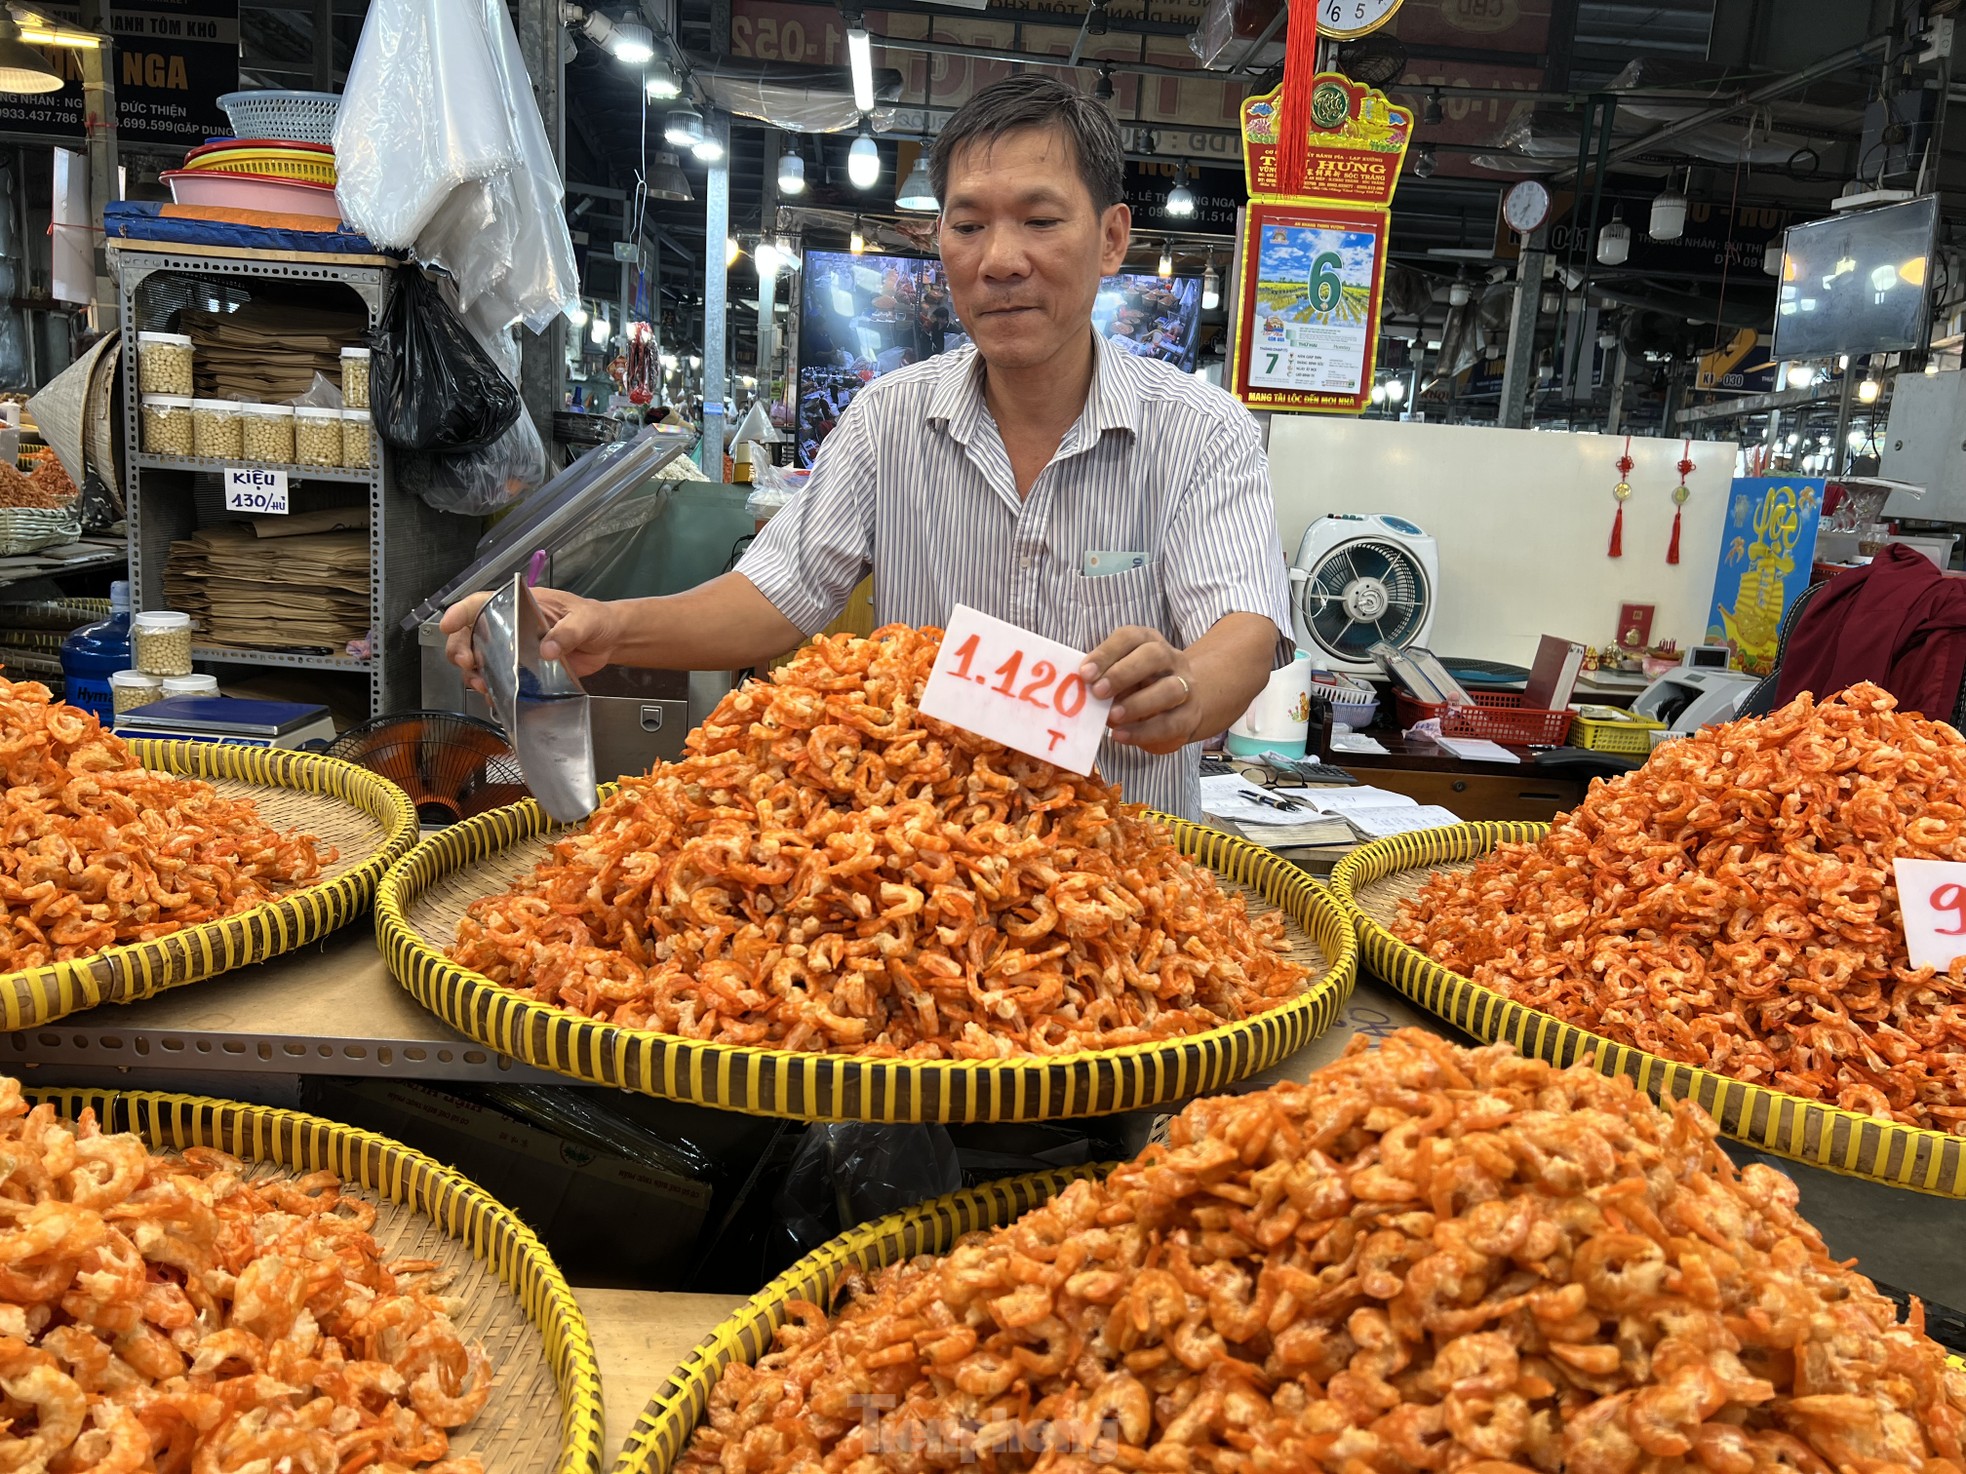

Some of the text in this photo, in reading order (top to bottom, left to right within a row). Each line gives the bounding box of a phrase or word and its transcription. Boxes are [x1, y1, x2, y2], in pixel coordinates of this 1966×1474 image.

[1330, 6, 1341, 22] 6
[1354, 3, 1365, 19] 5
[111, 15, 217, 38] ANH TÔM KHÔ
[122, 51, 190, 91] NGA
[0, 108, 77, 124] 933.437.786
[121, 101, 147, 114] ĐỨC
[150, 104, 187, 117] THIỆN
[1318, 160, 1386, 175] HƯNG
[1308, 250, 1343, 313] 6
[1265, 353, 1279, 374] 7
[1723, 373, 1744, 386] 030
[1248, 392, 1272, 402] MANG
[946, 633, 1087, 718] 1.120
[1047, 729, 1066, 751] T
